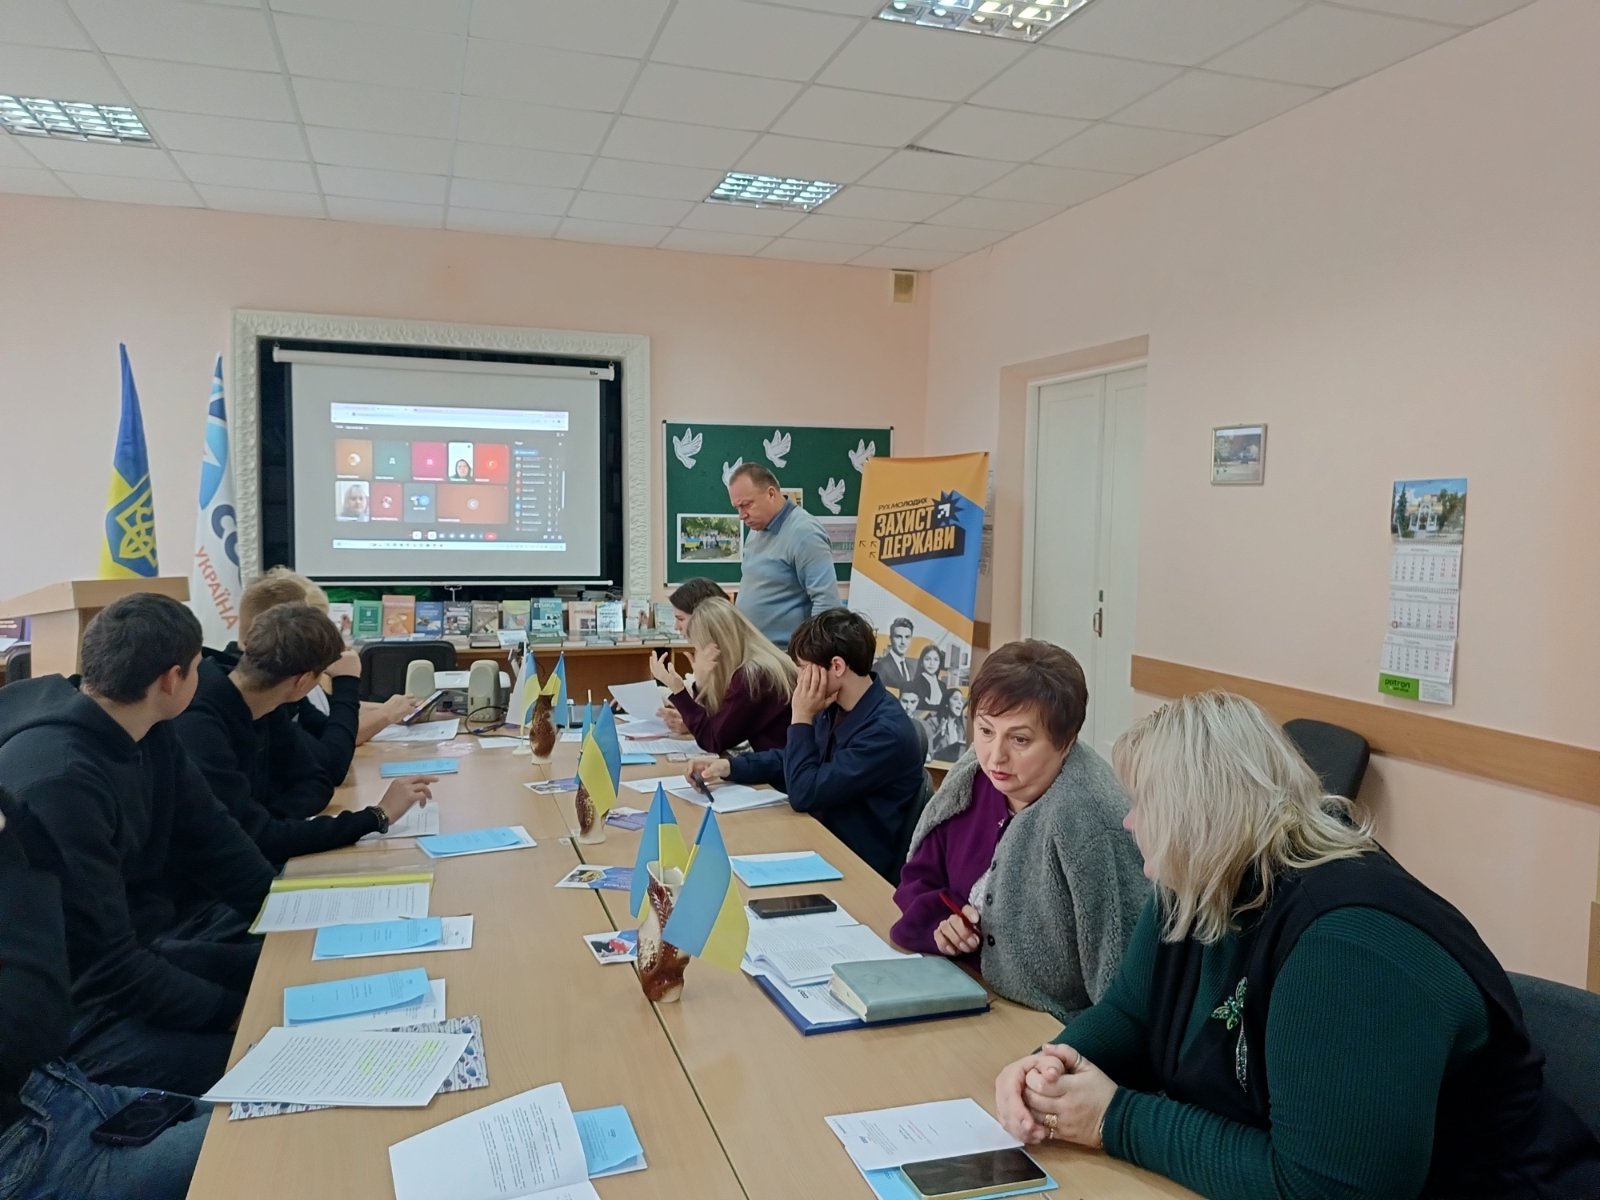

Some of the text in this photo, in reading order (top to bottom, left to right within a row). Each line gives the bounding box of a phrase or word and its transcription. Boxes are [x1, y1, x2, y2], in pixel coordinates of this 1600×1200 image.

[876, 506, 935, 537] ЗАХИСТ
[881, 526, 956, 560] ДЕРЖАВИ
[195, 545, 239, 631] УКРАЇНА
